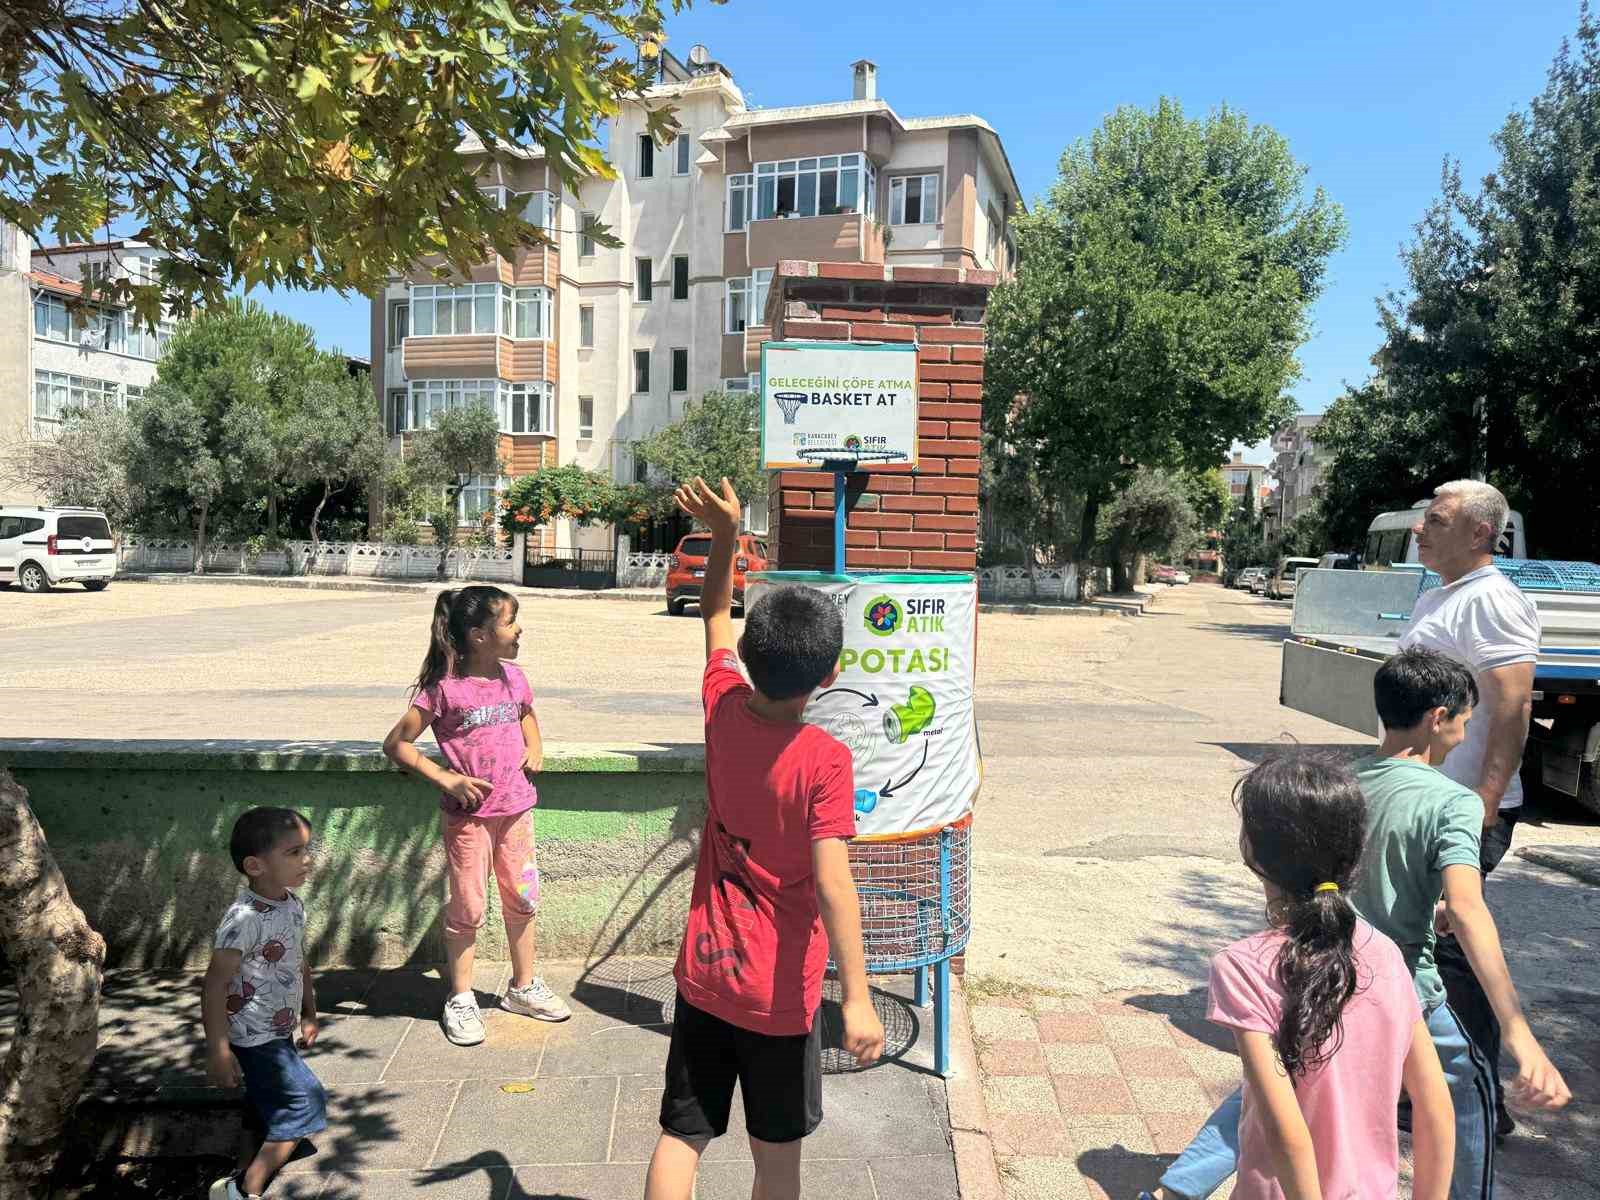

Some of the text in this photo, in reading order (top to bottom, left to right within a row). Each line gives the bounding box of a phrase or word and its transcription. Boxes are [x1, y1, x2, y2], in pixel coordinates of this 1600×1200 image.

[768, 376, 912, 391] GELECEĞİNİ ÇÖPE ATMA
[811, 393, 897, 406] BASKET AT
[863, 436, 887, 444] SIFIR
[906, 599, 945, 614] SIFIR
[906, 616, 945, 632] ATIK
[840, 648, 949, 673] POTASI
